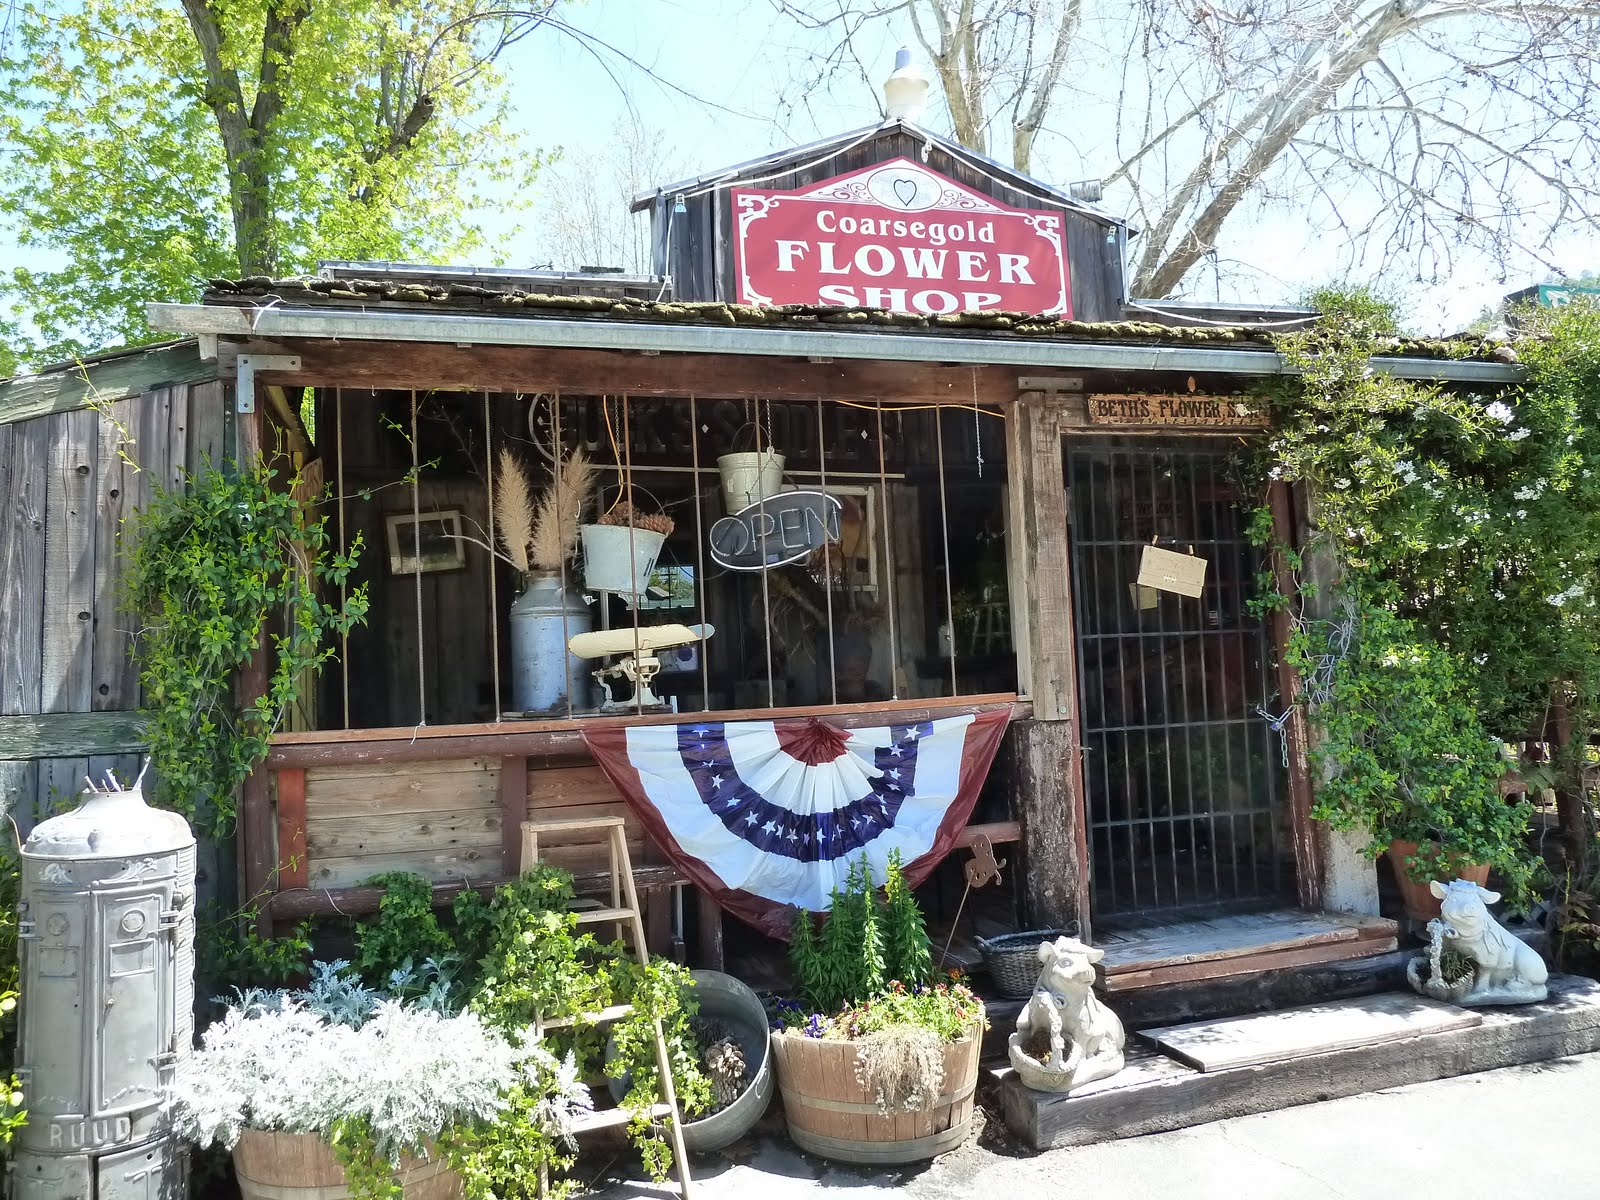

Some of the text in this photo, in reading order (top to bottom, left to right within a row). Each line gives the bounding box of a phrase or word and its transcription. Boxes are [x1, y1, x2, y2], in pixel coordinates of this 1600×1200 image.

[816, 210, 995, 245] Coarsegold
[775, 240, 1036, 285] FLOWER
[817, 285, 1002, 317] SHOP
[1158, 400, 1220, 419] FLOWER
[709, 505, 840, 557] OPEN
[49, 1115, 131, 1149] RUUD
